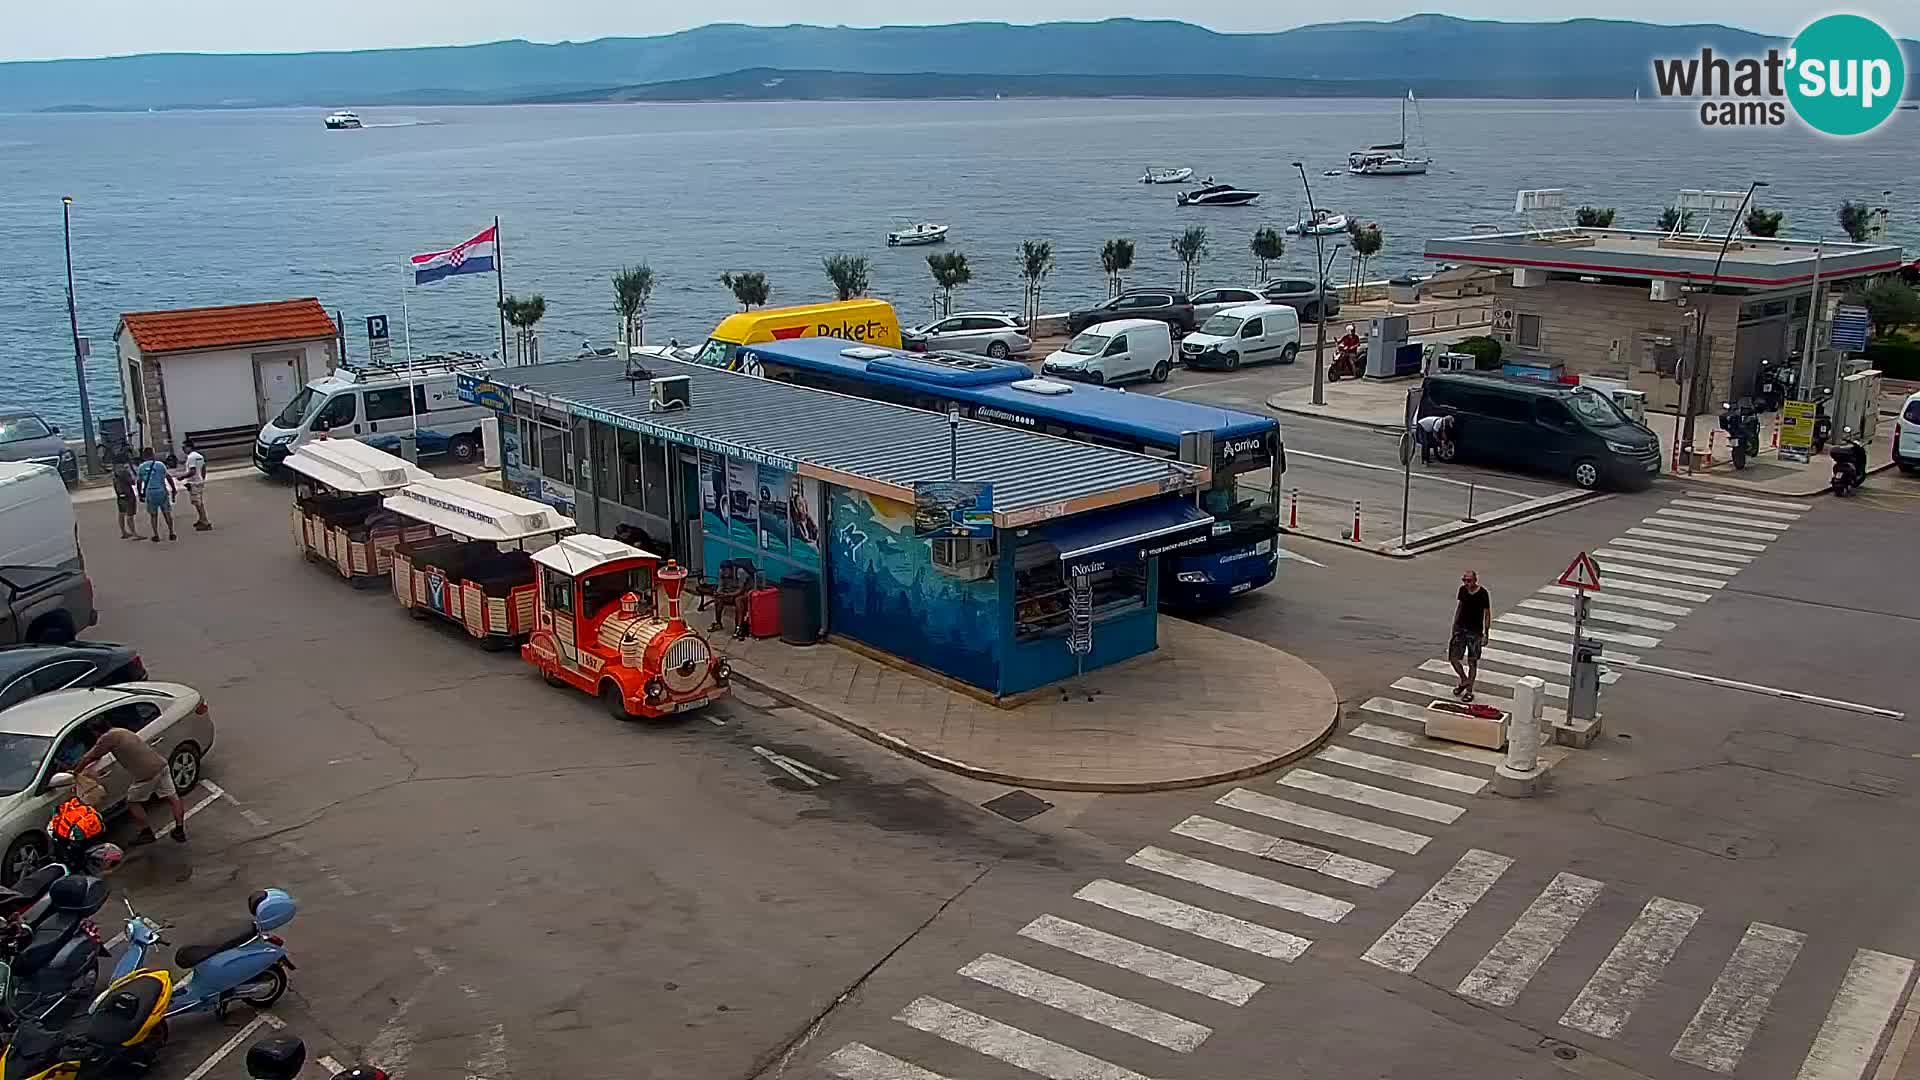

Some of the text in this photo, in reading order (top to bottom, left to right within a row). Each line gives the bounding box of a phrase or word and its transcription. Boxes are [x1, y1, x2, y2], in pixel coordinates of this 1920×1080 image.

[372, 319, 383, 336] P
[818, 320, 881, 341] Paket
[616, 417, 653, 435] AUTOBUSNA
[654, 427, 684, 443] POSTAJA
[694, 438, 794, 470] BUS STATION TICKET OFFICE
[1234, 439, 1260, 452] arriva
